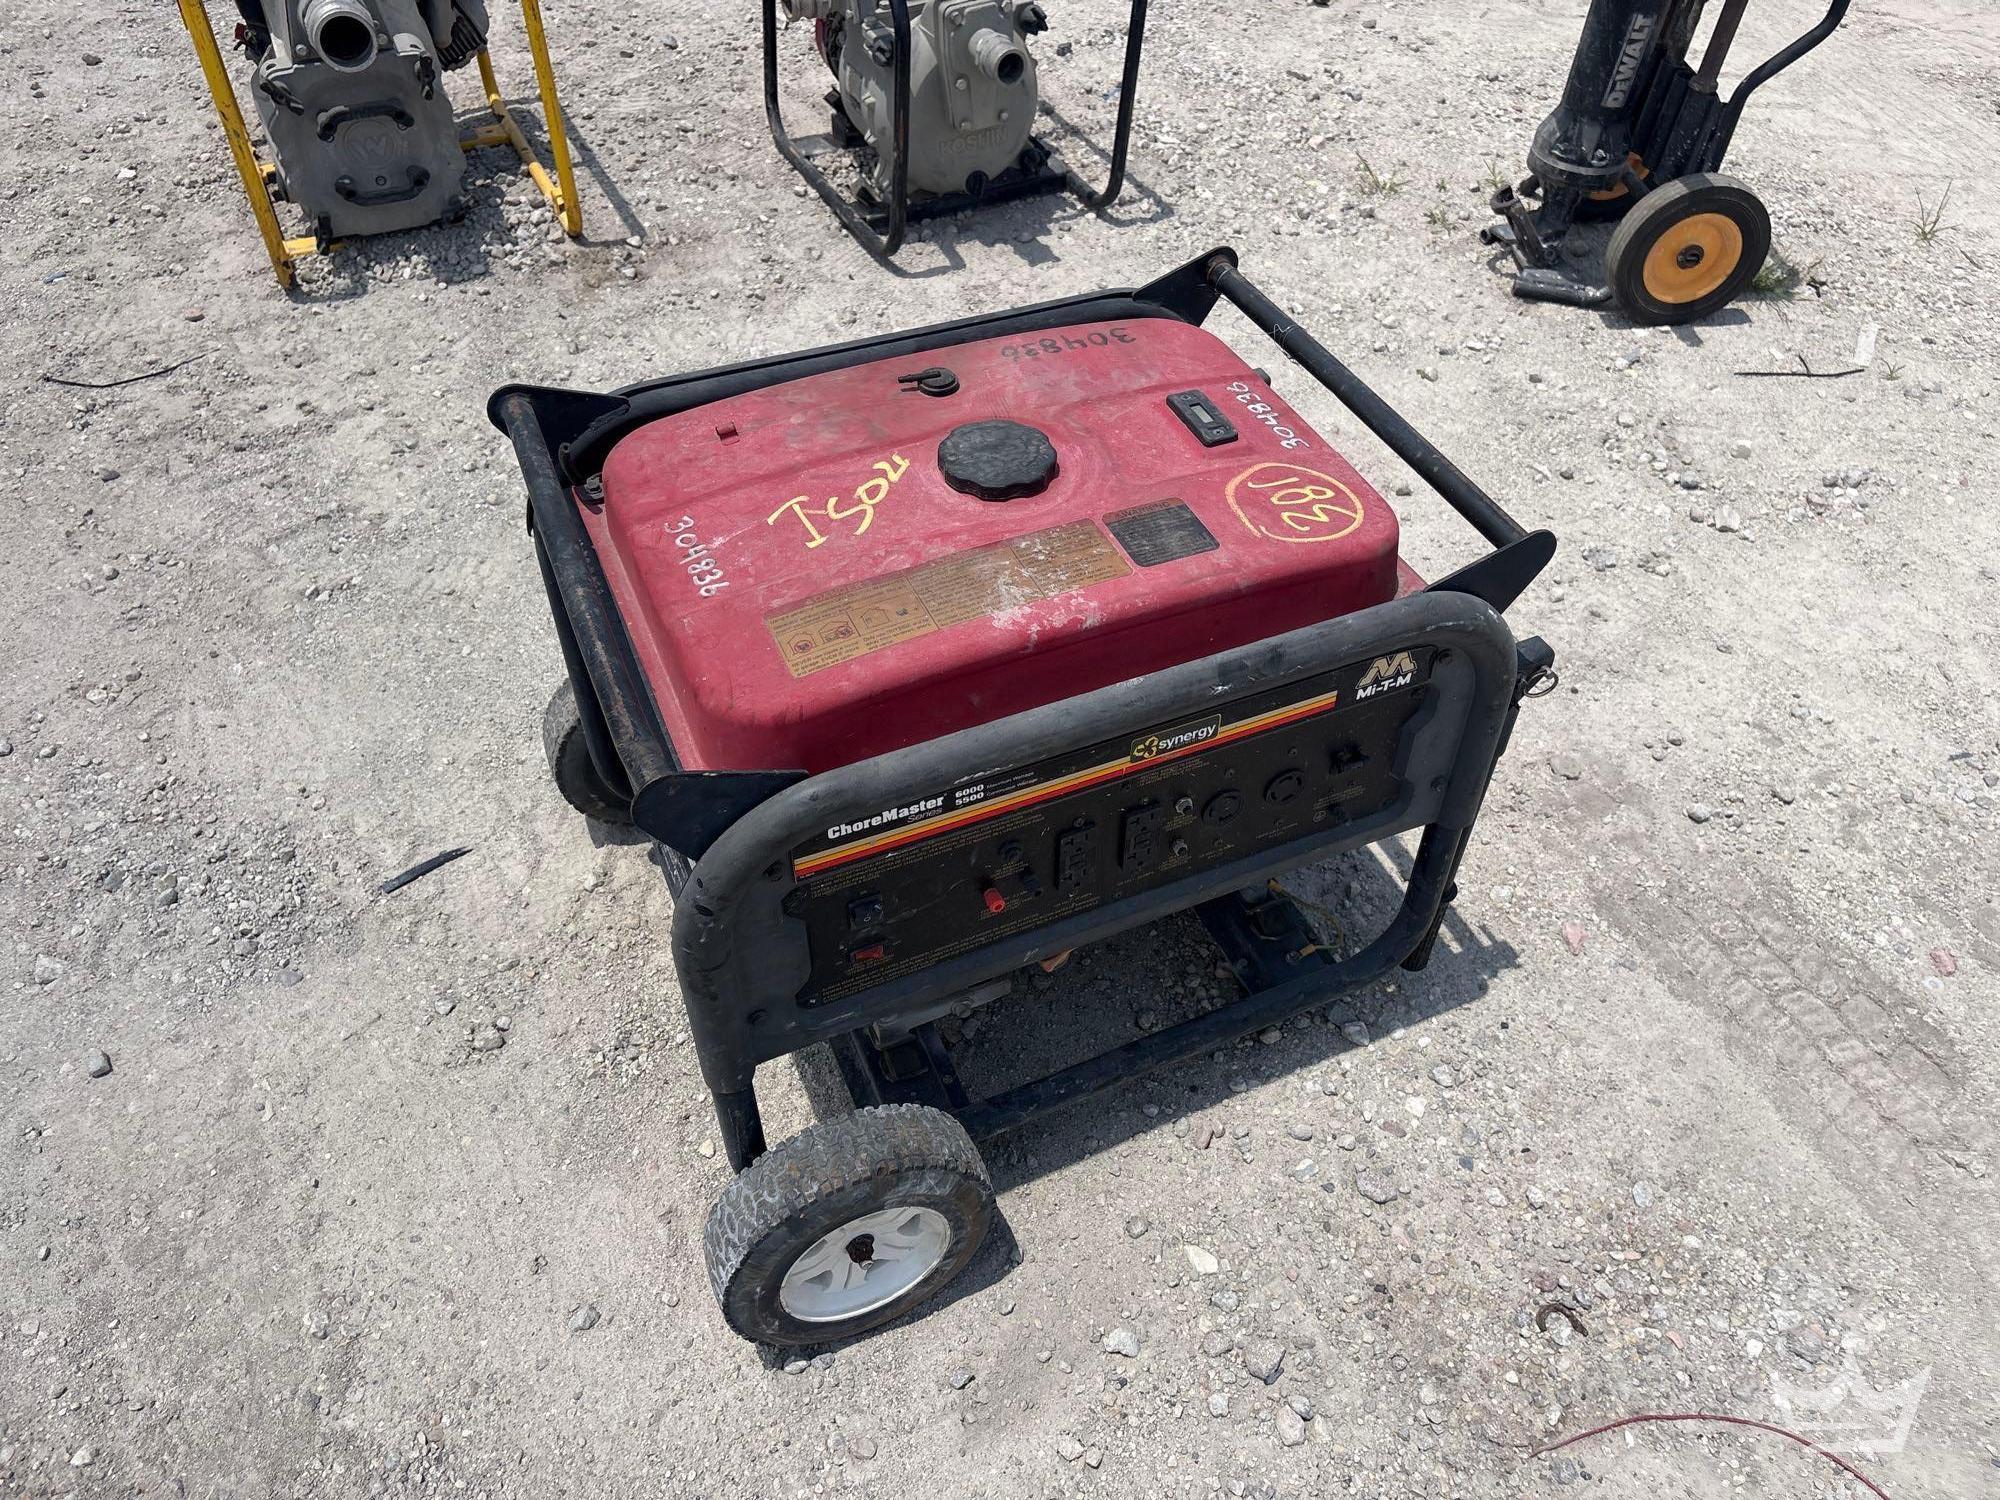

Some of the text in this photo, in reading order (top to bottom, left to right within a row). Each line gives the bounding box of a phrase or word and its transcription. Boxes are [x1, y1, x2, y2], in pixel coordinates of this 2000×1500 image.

[1606, 13, 1656, 108] DEWALT
[938, 126, 1009, 155] KOSHIN
[1001, 327, 1136, 362] 304836
[1226, 381, 1310, 449] 304836
[663, 515, 730, 597] 304836
[1355, 672, 1413, 700] Mi-T-M
[1158, 724, 1217, 750] synergy
[955, 784, 985, 798] 6000
[955, 792, 985, 806] 5500
[827, 796, 945, 840] ChoreMaster
[907, 807, 943, 823] Series
